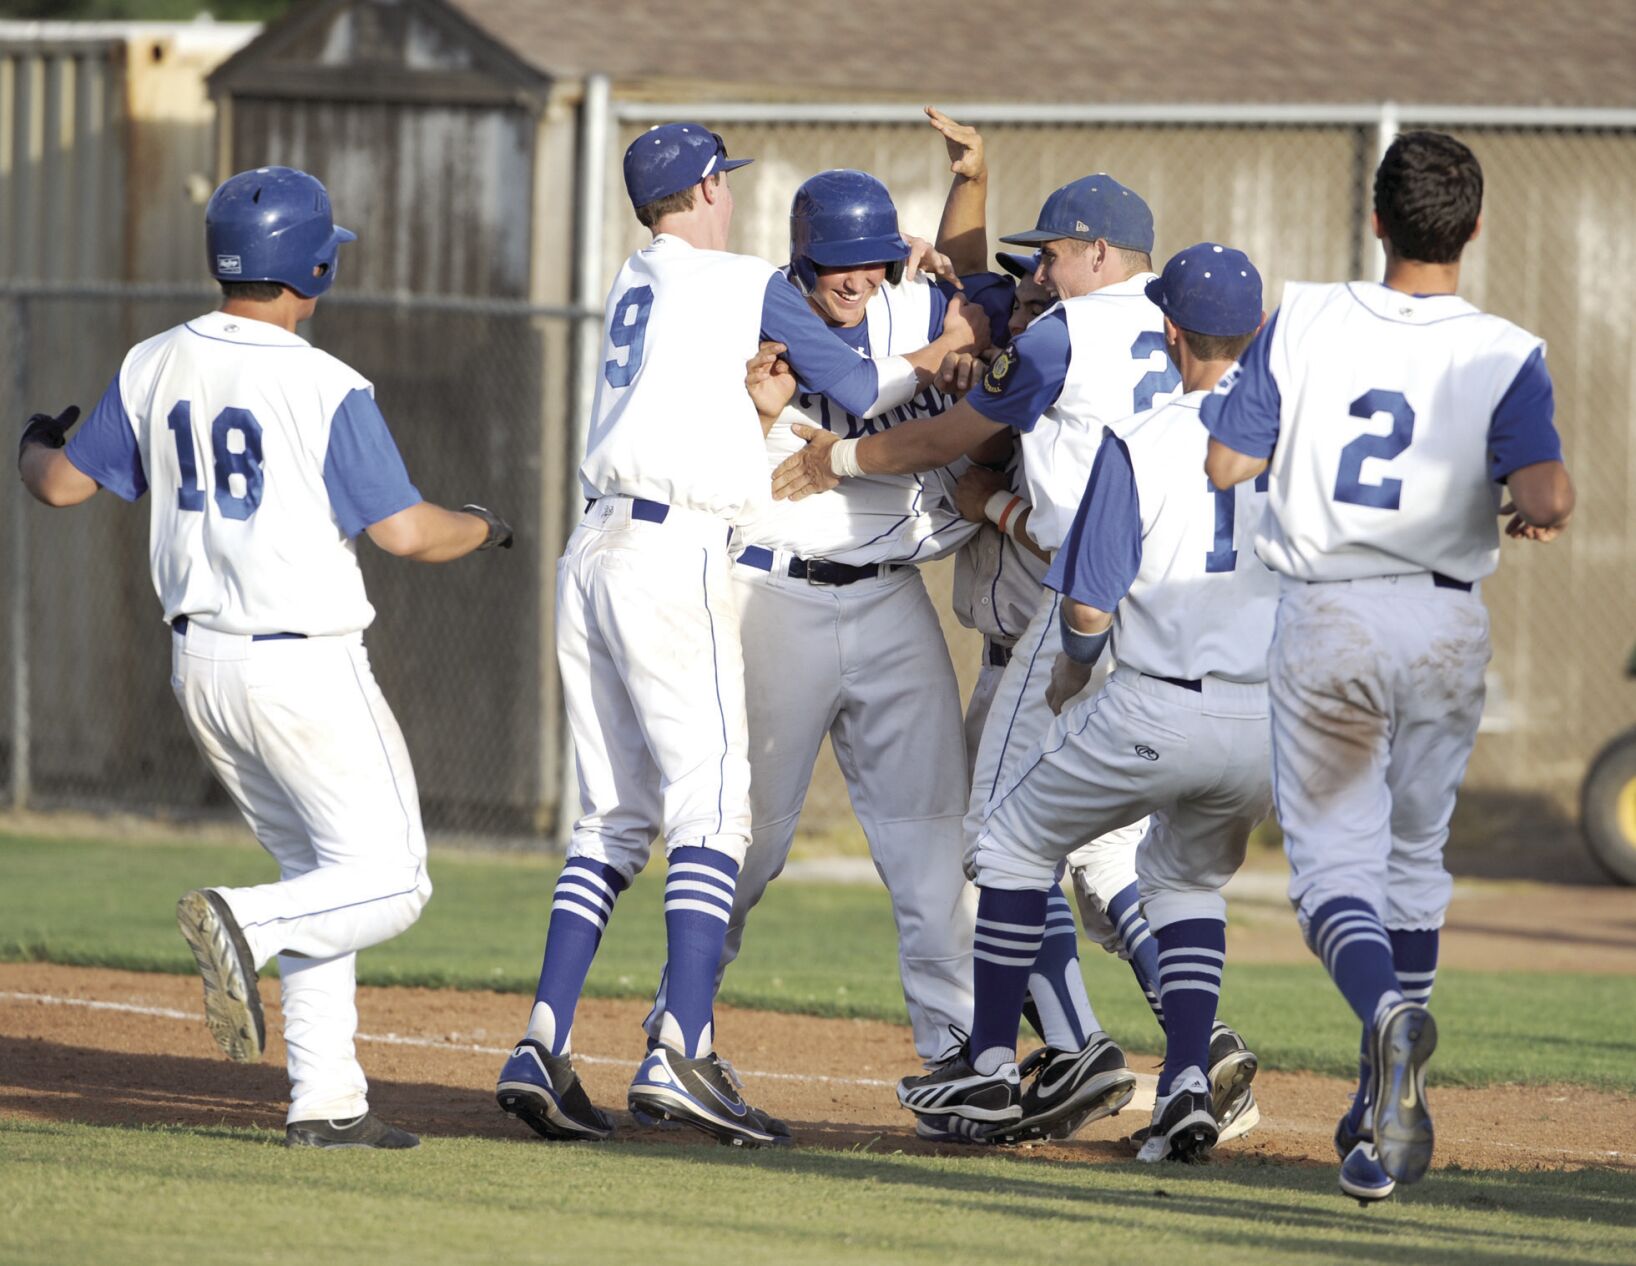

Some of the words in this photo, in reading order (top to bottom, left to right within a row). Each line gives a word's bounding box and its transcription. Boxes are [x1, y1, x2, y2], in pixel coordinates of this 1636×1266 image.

[605, 285, 655, 389] 9
[1130, 330, 1183, 414] 2
[167, 399, 264, 521] 18
[1333, 388, 1415, 511] 2
